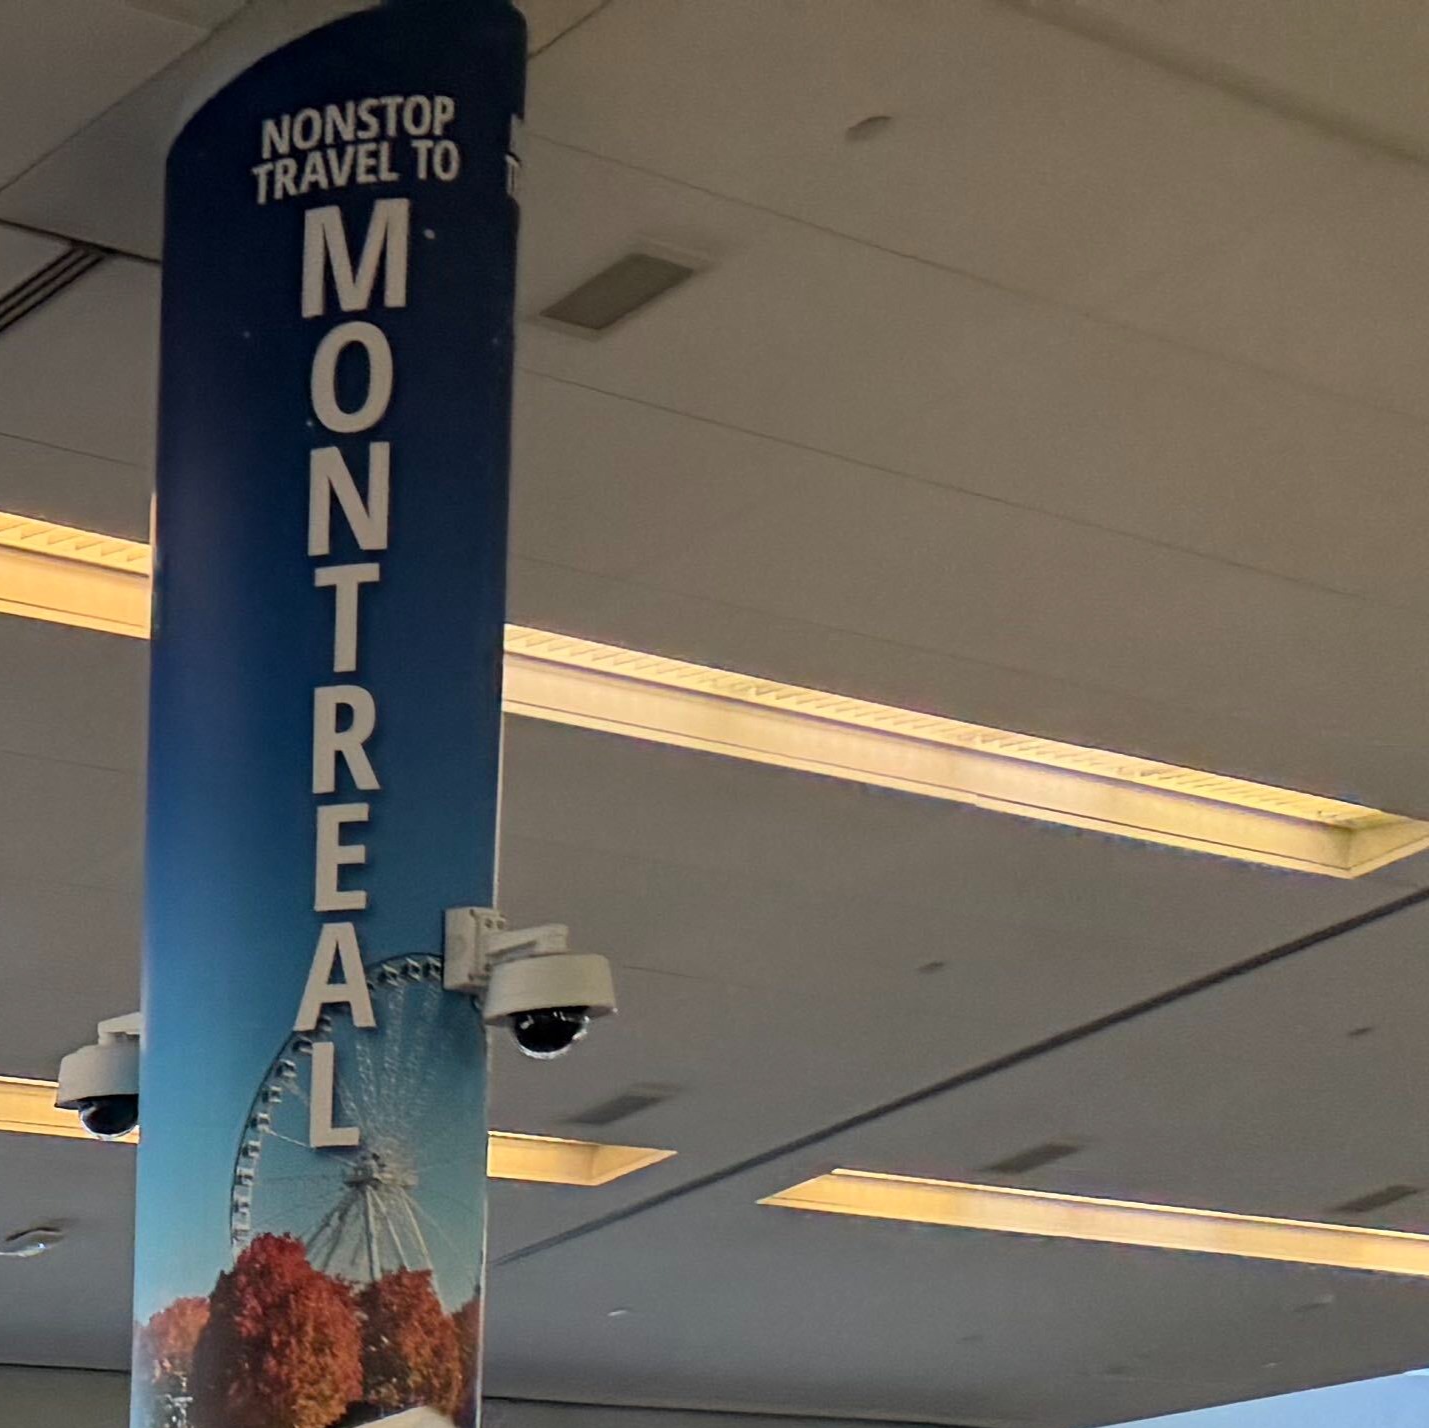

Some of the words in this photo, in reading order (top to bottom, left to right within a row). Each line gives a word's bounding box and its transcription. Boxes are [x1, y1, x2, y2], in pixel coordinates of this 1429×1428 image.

[260, 96, 455, 160] NONSTOP
[252, 142, 400, 204] TRAVEL
[412, 139, 460, 182] TO
[294, 198, 410, 1149] MONTREAL
